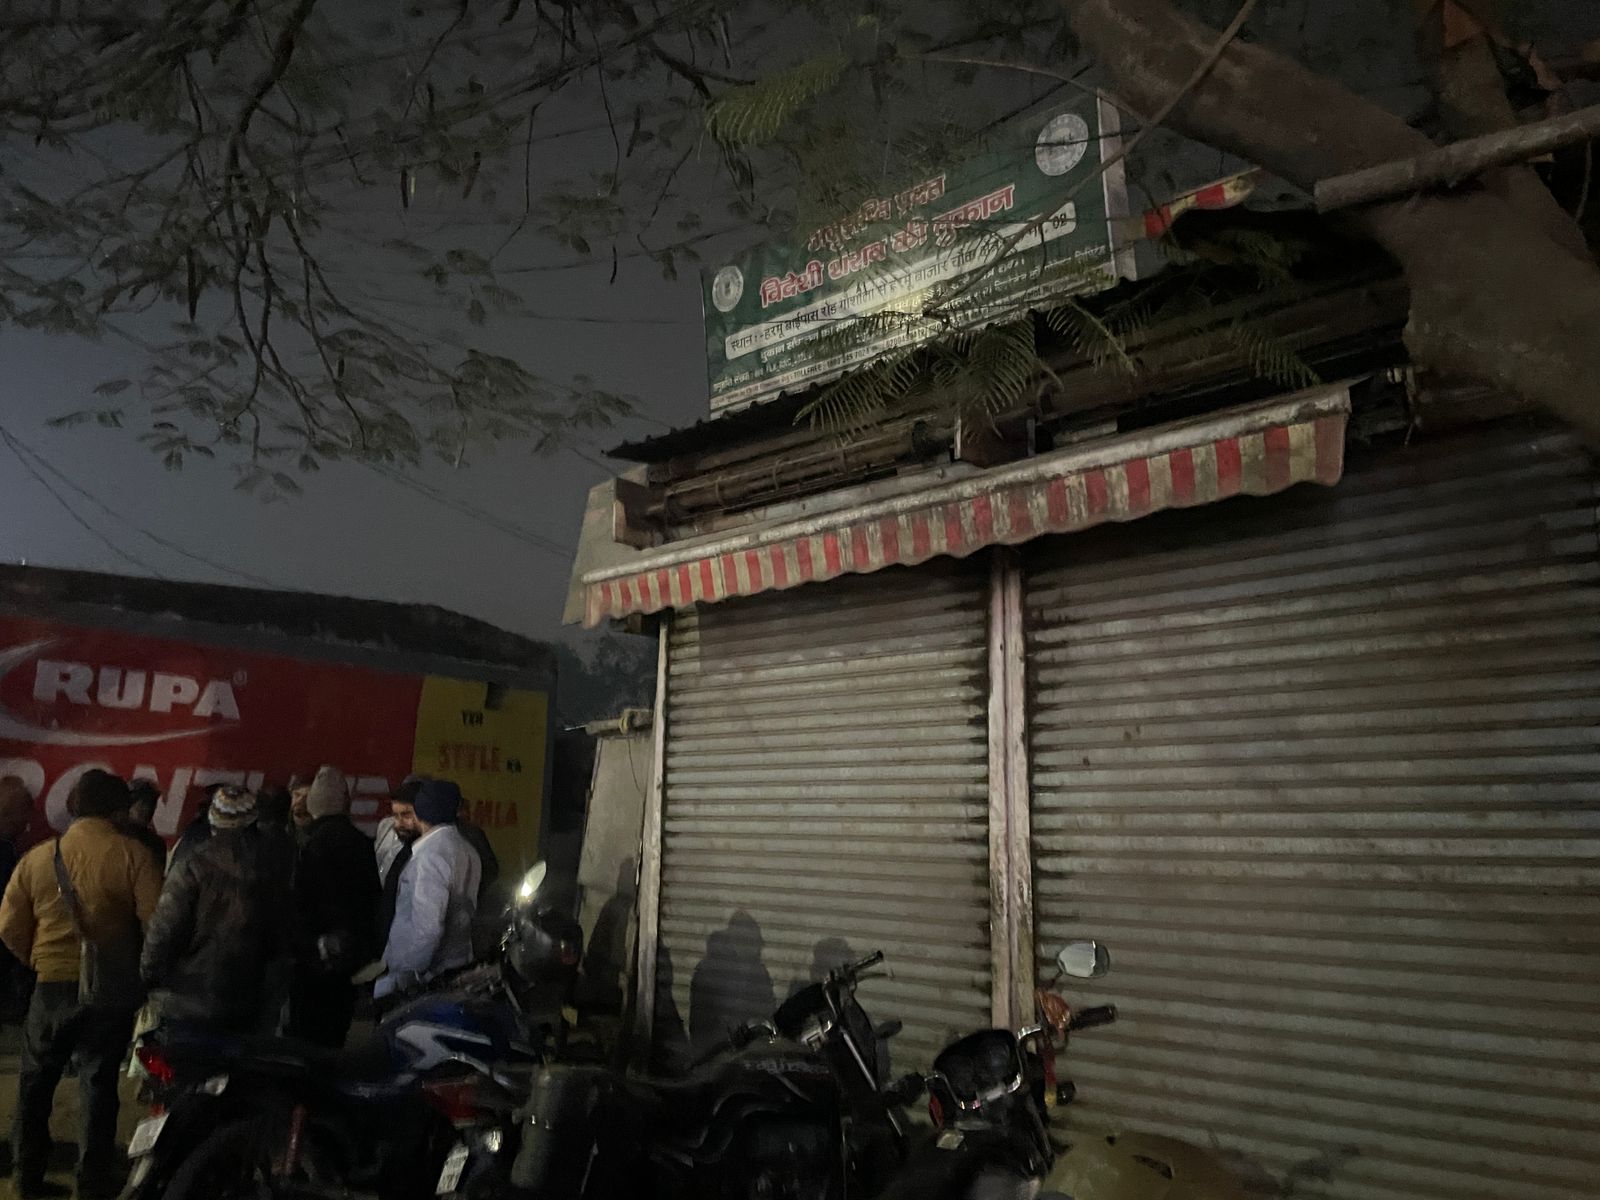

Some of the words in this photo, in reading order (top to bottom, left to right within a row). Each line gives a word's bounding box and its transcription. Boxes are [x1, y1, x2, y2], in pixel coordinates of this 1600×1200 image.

[760, 260, 825, 309] विदेशी
[828, 239, 888, 280] शराब
[33, 659, 241, 722] RUPA
